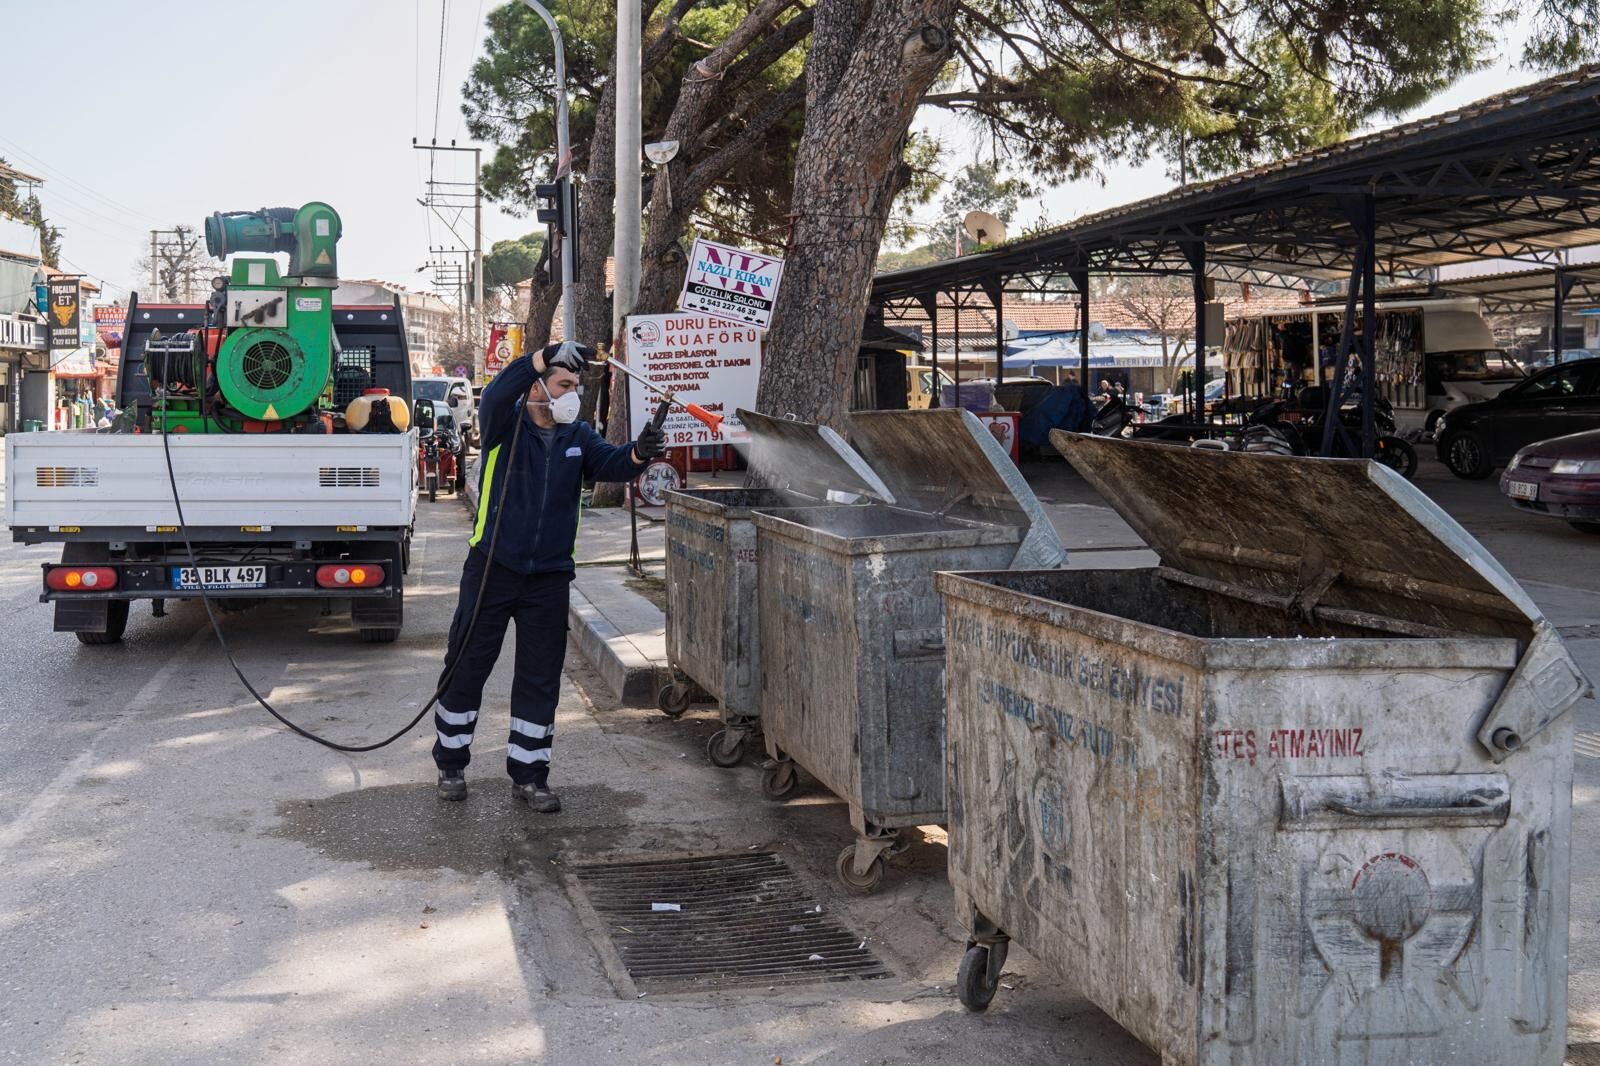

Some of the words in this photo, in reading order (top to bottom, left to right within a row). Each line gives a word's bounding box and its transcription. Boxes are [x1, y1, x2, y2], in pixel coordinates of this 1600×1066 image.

[697, 260, 733, 279] NAZLI
[735, 269, 773, 288] KIRAN
[58, 295, 72, 306] ET
[694, 285, 732, 302] GÜZELLİK
[733, 294, 766, 309] SALONU
[706, 299, 721, 308] 543
[721, 302, 736, 311] 227
[736, 306, 746, 314] 46
[747, 308, 757, 316] 38
[665, 318, 705, 331] DURU
[666, 328, 757, 347] KUAFÖRÜ
[648, 351, 673, 361] LAZER
[674, 349, 717, 359] EPİLASYON
[648, 362, 704, 372] PROFESYONEL
[704, 359, 722, 368] CİLT
[723, 358, 751, 367] BAKIMI
[649, 372, 681, 382] KERATİN
[682, 371, 710, 381] BOTOX
[667, 383, 701, 392] BOYAMA
[672, 431, 694, 443] 182
[696, 430, 708, 442] 71
[711, 430, 724, 441] 91
[181, 569, 198, 584] 35
[204, 568, 231, 583] BLK
[237, 567, 264, 583] 497
[1268, 728, 1365, 759] ATMAYINIZ
